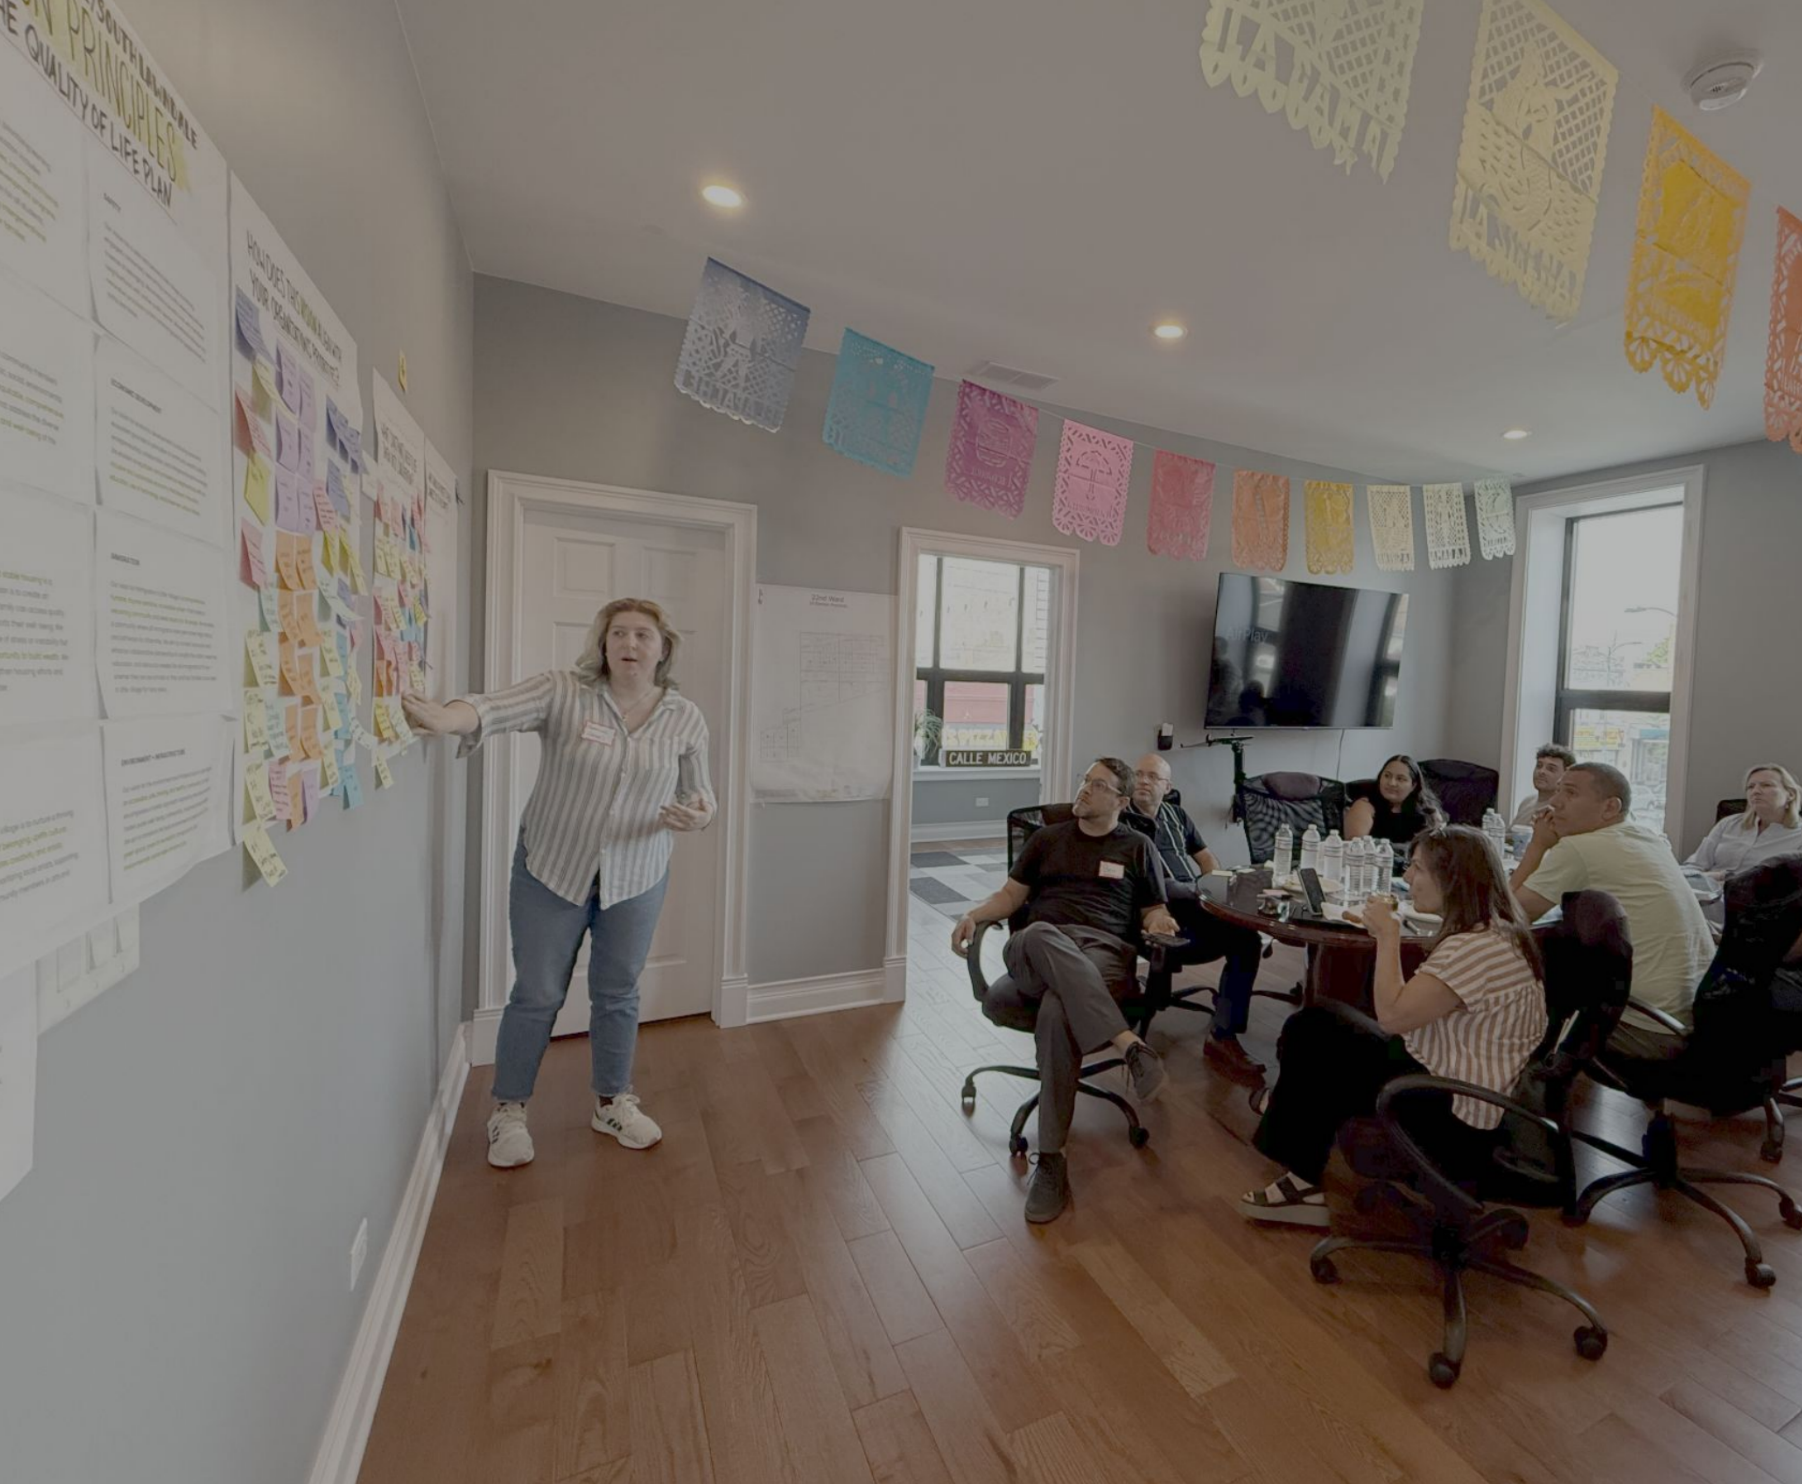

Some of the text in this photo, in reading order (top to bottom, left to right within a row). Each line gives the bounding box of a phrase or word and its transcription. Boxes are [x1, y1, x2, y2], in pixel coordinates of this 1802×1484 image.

[0, 1, 18, 35] HE
[25, 24, 89, 125] QUALITY
[91, 103, 108, 137] OF
[111, 121, 140, 175] LIFE
[143, 157, 172, 208] PLAN
[67, 2, 177, 182] PRINCIPLES
[247, 229, 266, 273] HOW
[266, 253, 286, 298] DOES
[249, 268, 270, 311] YOUR
[1226, 626, 1268, 645] AirPlay
[948, 751, 1027, 765] CALLE MEXICO
